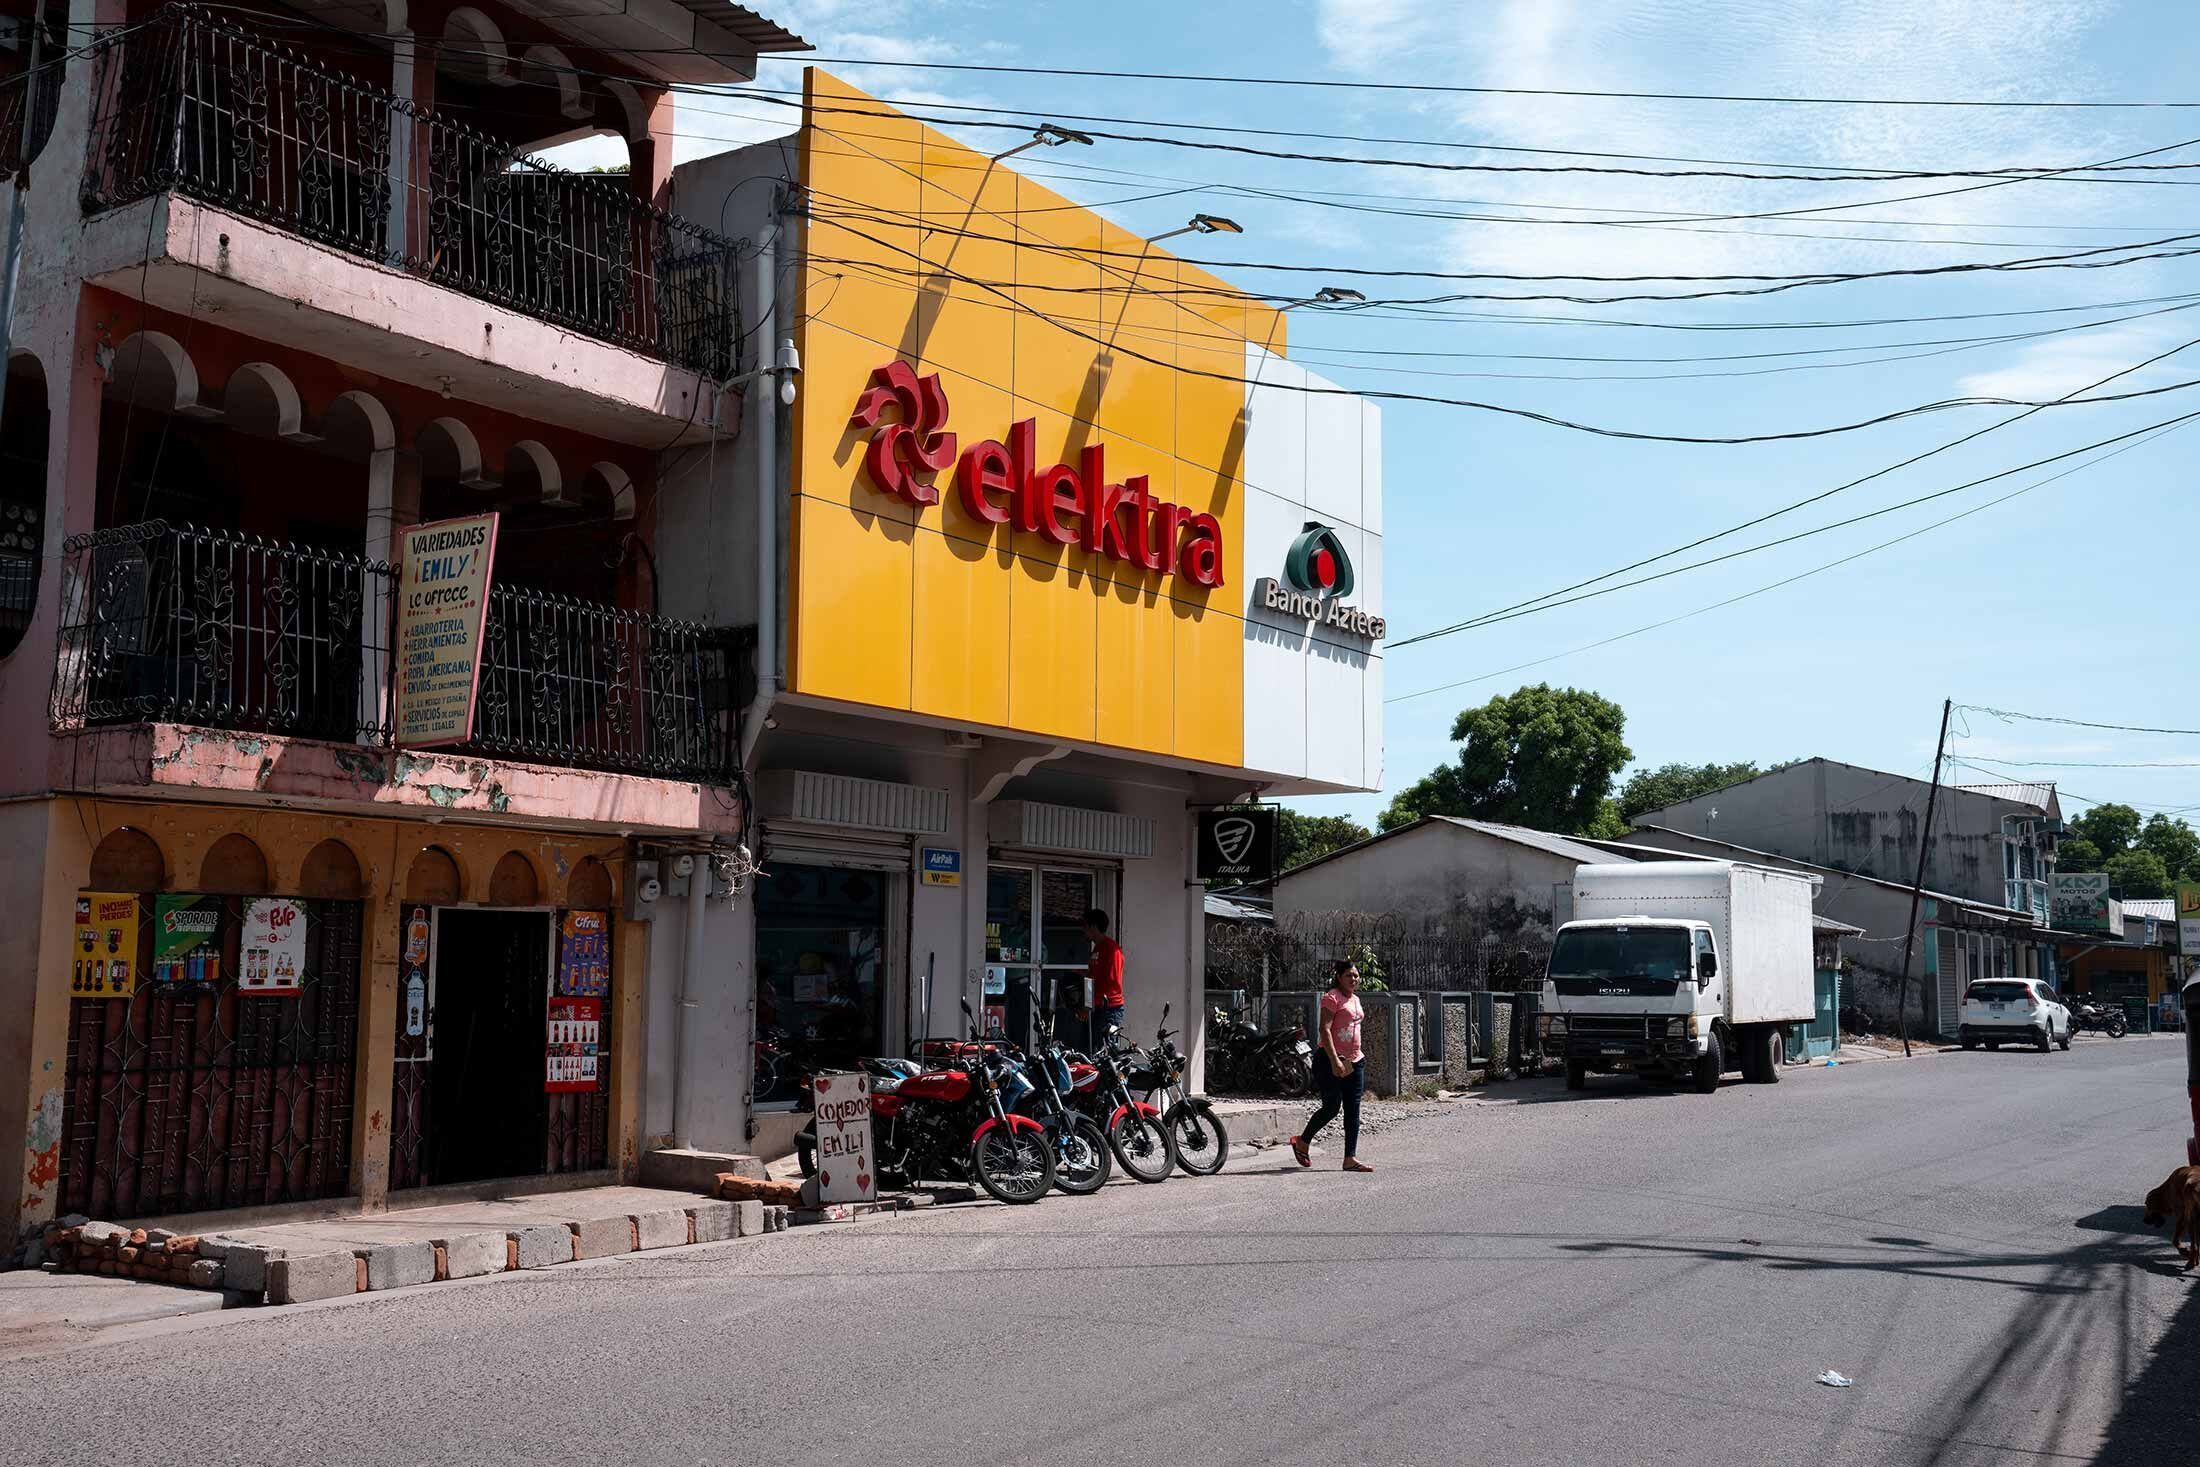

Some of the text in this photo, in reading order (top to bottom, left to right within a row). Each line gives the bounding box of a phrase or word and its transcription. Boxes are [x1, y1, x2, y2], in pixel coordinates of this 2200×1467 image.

[957, 416, 1225, 589] elektra
[411, 526, 486, 555] VARIEDADES
[1262, 577, 1385, 639] Banco Azteca
[409, 618, 465, 637] ABARROTERIA
[408, 632, 468, 652] HERRAMIENTAS
[408, 650, 435, 666] COMIDA
[407, 660, 471, 680] ROPA AMERICANA
[408, 680, 431, 694] ENVIOS
[408, 708, 441, 723] SERVICIOS
[432, 720, 456, 731] LEGALES
[930, 853, 953, 865] AirPak
[1217, 865, 1251, 873] ITALIKA
[2054, 876, 2102, 889] KM
[175, 910, 218, 926] SPORADE
[269, 905, 296, 930] Pulp
[1599, 987, 1631, 995] ISUZU
[817, 1097, 872, 1121] COMEDOR
